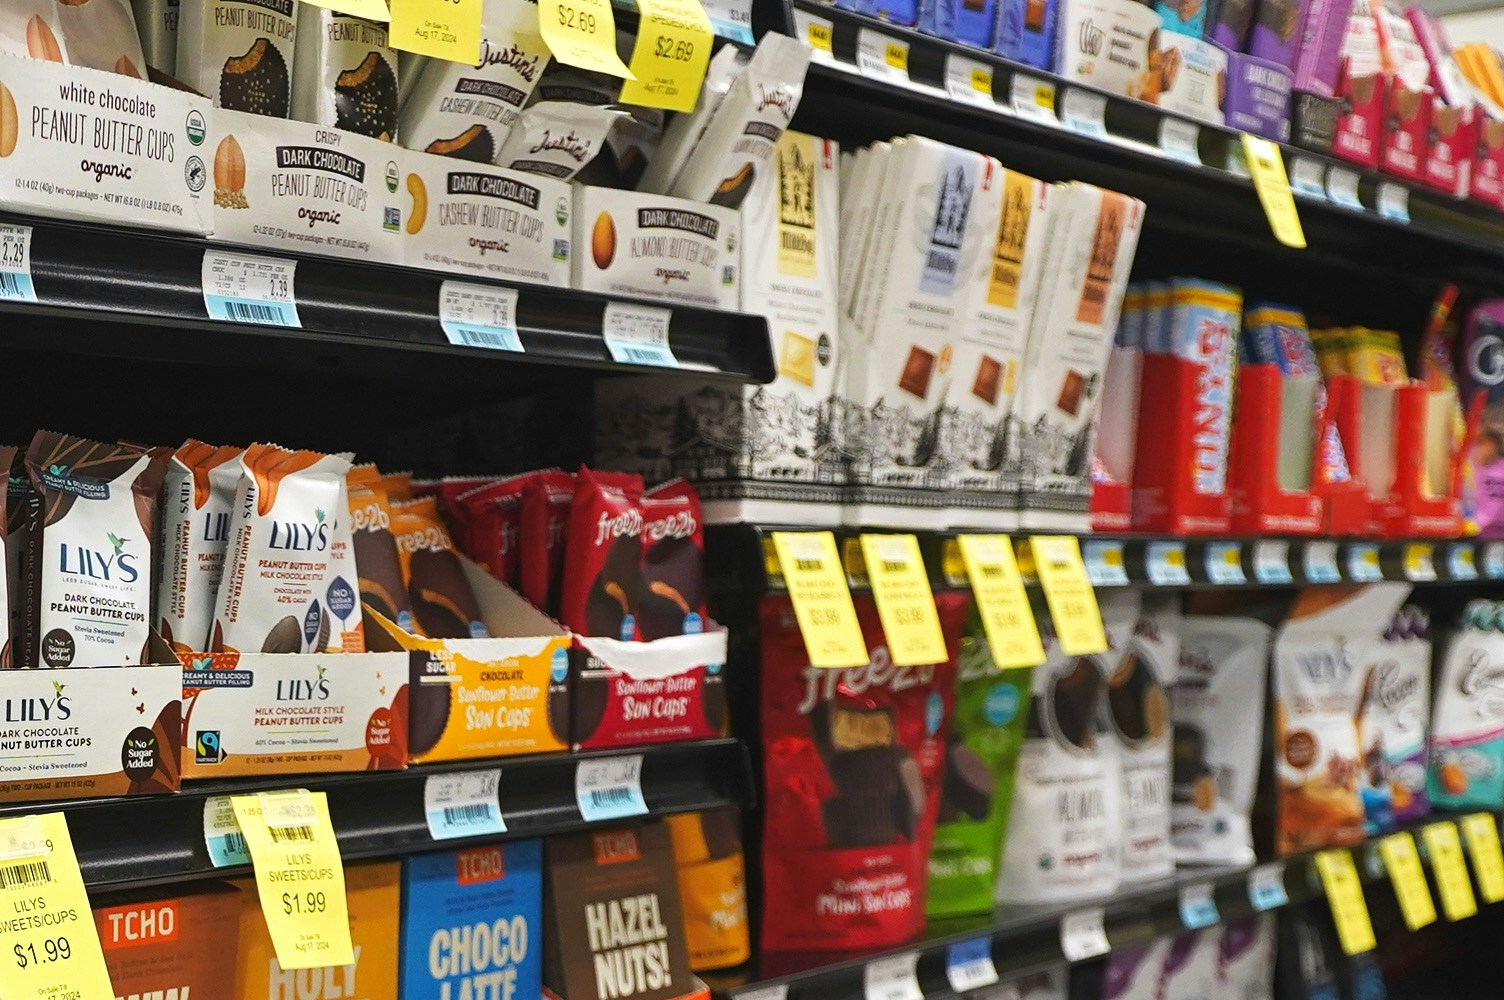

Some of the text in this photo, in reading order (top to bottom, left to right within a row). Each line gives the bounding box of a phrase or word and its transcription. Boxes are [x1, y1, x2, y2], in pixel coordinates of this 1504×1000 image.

[559, 5, 596, 34] $2.69
[474, 39, 540, 83] Justin's
[60, 82, 156, 118] white chocolate
[32, 106, 174, 163] PEANUT BUTTER CUPS
[316, 130, 342, 146] CRISPY
[81, 159, 132, 182] organic
[284, 150, 362, 179] DARK CHOCOLATE
[76, 188, 98, 202] packages
[272, 174, 368, 212] PEANUT BUTTER CUPS
[452, 175, 537, 205] DARK CHOCOLATE
[298, 206, 341, 228] organic
[2, 242, 24, 262] 2.29
[270, 279, 288, 297] 2.39
[255, 707, 276, 715] MILK
[278, 706, 322, 715] CHOCOLATE
[23, 727, 79, 738] CHOCOLATE
[24, 739, 63, 749] BUTTER
[65, 737, 92, 748] CUPS
[128, 748, 153, 761] Sugar
[135, 740, 147, 749] No
[0, 764, 21, 773] Cocoa
[28, 763, 49, 772] Stevia
[50, 761, 88, 770] Sweetened
[127, 759, 153, 769] Added
[14, 897, 46, 914] LILYS
[282, 892, 327, 916] $1.99
[108, 907, 174, 942] TCHO
[585, 894, 668, 952] HAZEL
[14, 937, 72, 969] $1.99
[429, 915, 529, 981] CHOCO
[593, 943, 673, 1000] NUTS!
